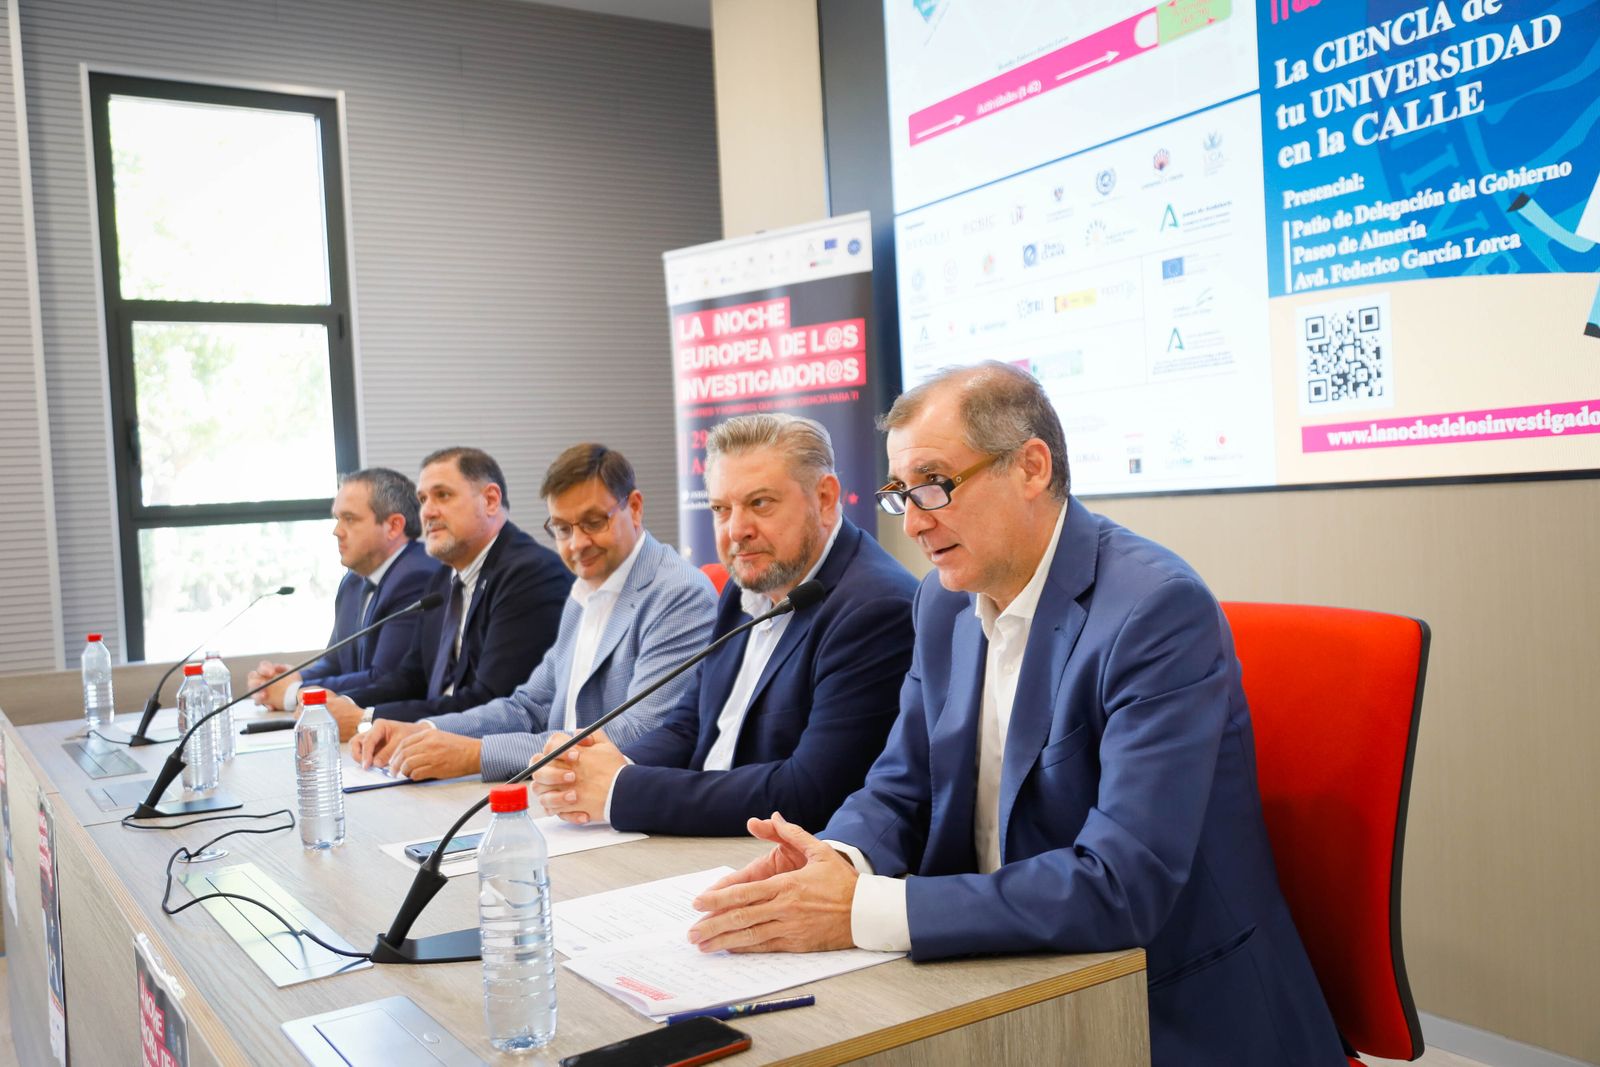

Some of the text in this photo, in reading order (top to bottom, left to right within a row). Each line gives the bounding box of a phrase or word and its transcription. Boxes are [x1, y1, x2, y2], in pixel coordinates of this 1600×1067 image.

[1274, 57, 1309, 89] La
[1312, 1, 1455, 73] CIENCIA
[1461, 0, 1502, 23] de
[1275, 13, 1562, 131] tu UNIVERSIDAD
[1278, 81, 1485, 169] en la CALLE
[1282, 173, 1365, 209] Presencial:
[1292, 159, 1572, 239] Patio de Delegación del Gobierno
[1292, 220, 1427, 265] Paseo de Almería
[1293, 230, 1522, 292] Avd. Federico García Lorca
[678, 302, 785, 341] LA NOCHE
[680, 325, 859, 370] EUROPEA DE L@S
[682, 357, 860, 401] INVESTIGADOR@S
